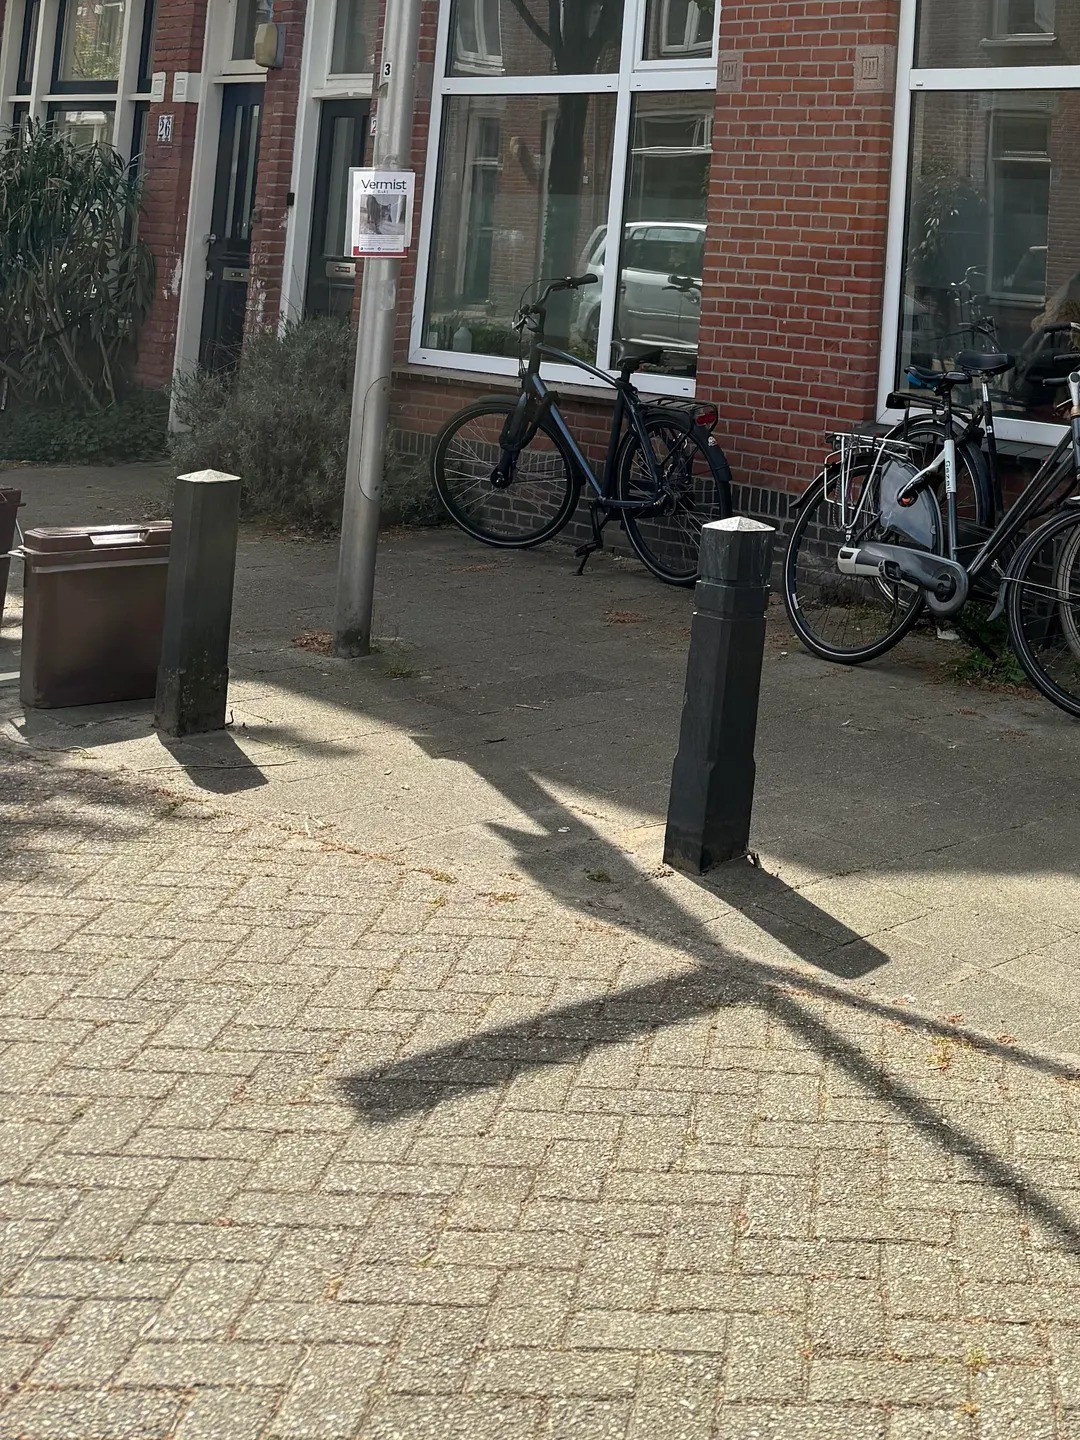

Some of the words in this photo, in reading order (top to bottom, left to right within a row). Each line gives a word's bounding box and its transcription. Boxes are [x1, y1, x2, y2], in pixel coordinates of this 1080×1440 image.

[384, 63, 391, 76] 3
[159, 120, 171, 137] 26
[361, 178, 407, 190] Vermist
